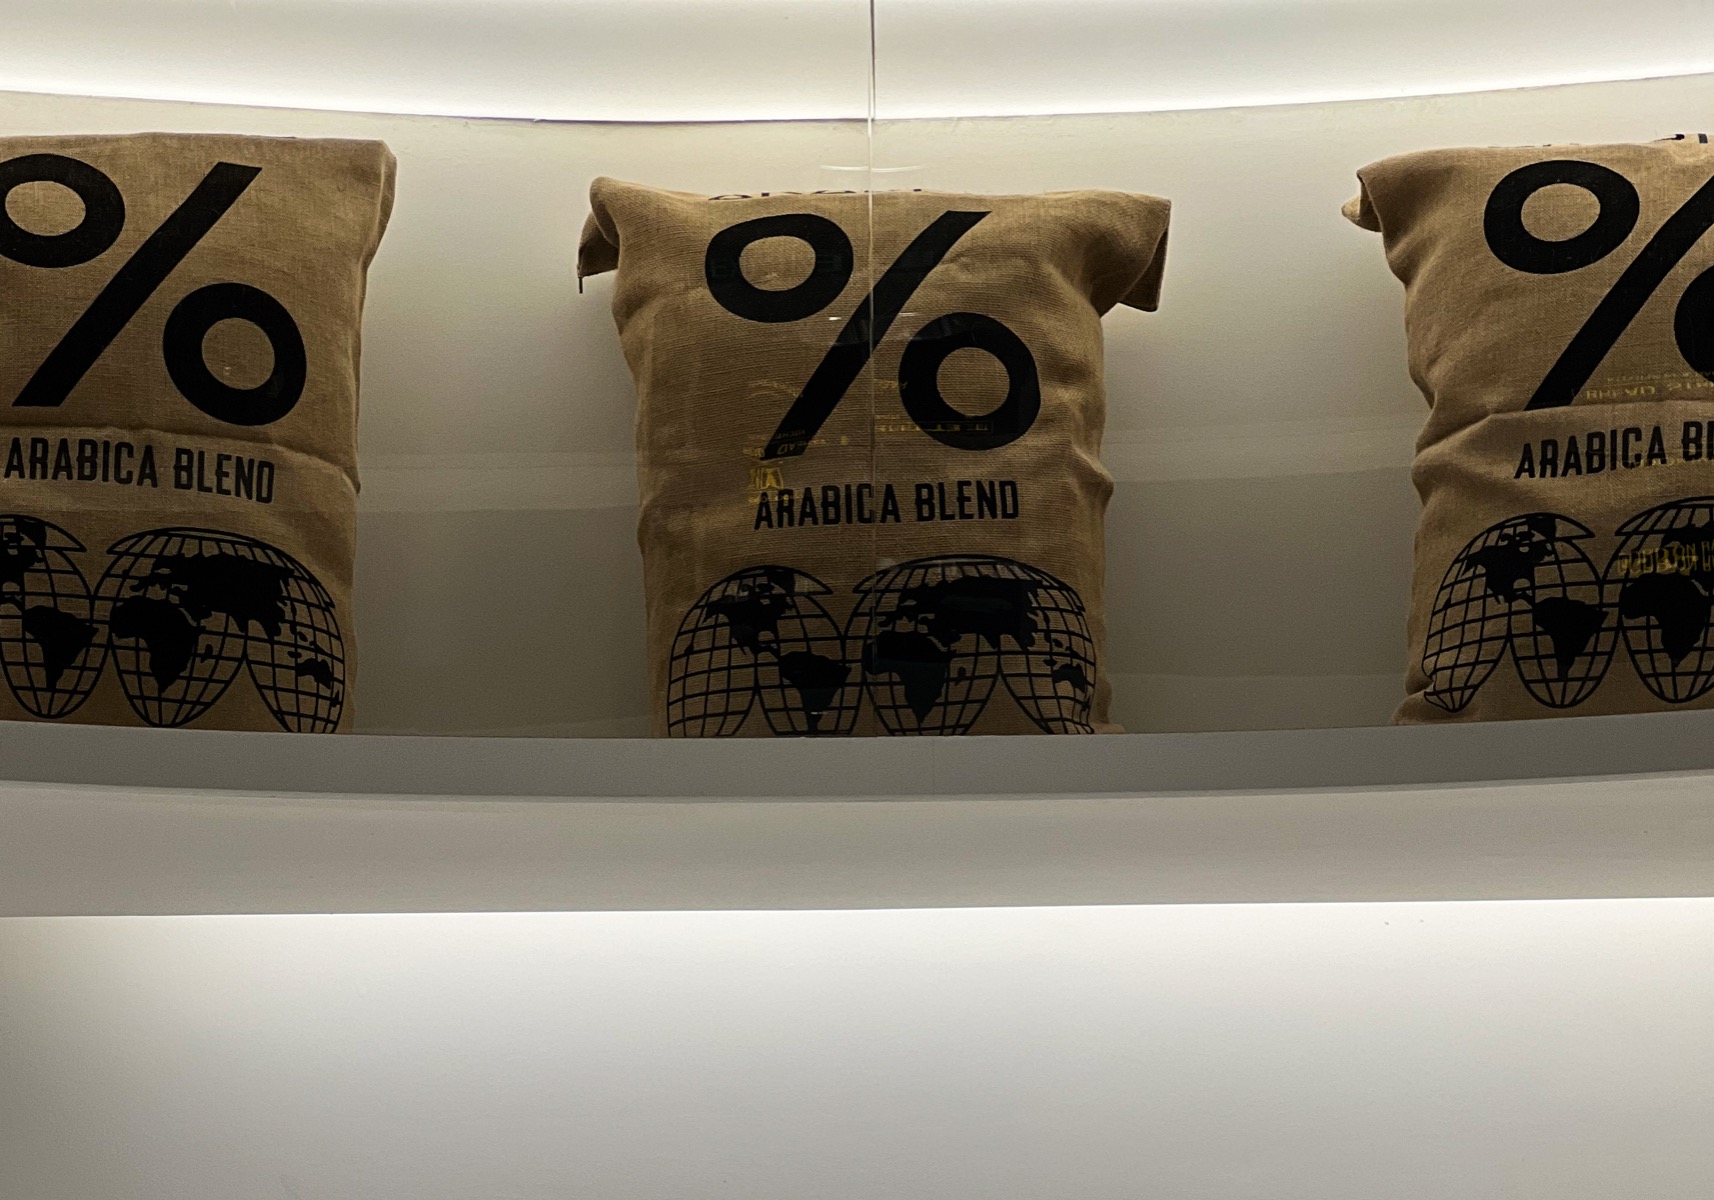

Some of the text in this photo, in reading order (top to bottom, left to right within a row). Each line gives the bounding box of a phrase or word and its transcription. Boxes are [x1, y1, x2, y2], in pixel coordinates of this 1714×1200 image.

[705, 209, 1042, 461] %
[4, 437, 276, 504] ARABICA BLEND
[1514, 426, 1666, 479] ARABICA
[754, 480, 1019, 531] ARABICA BLEND
